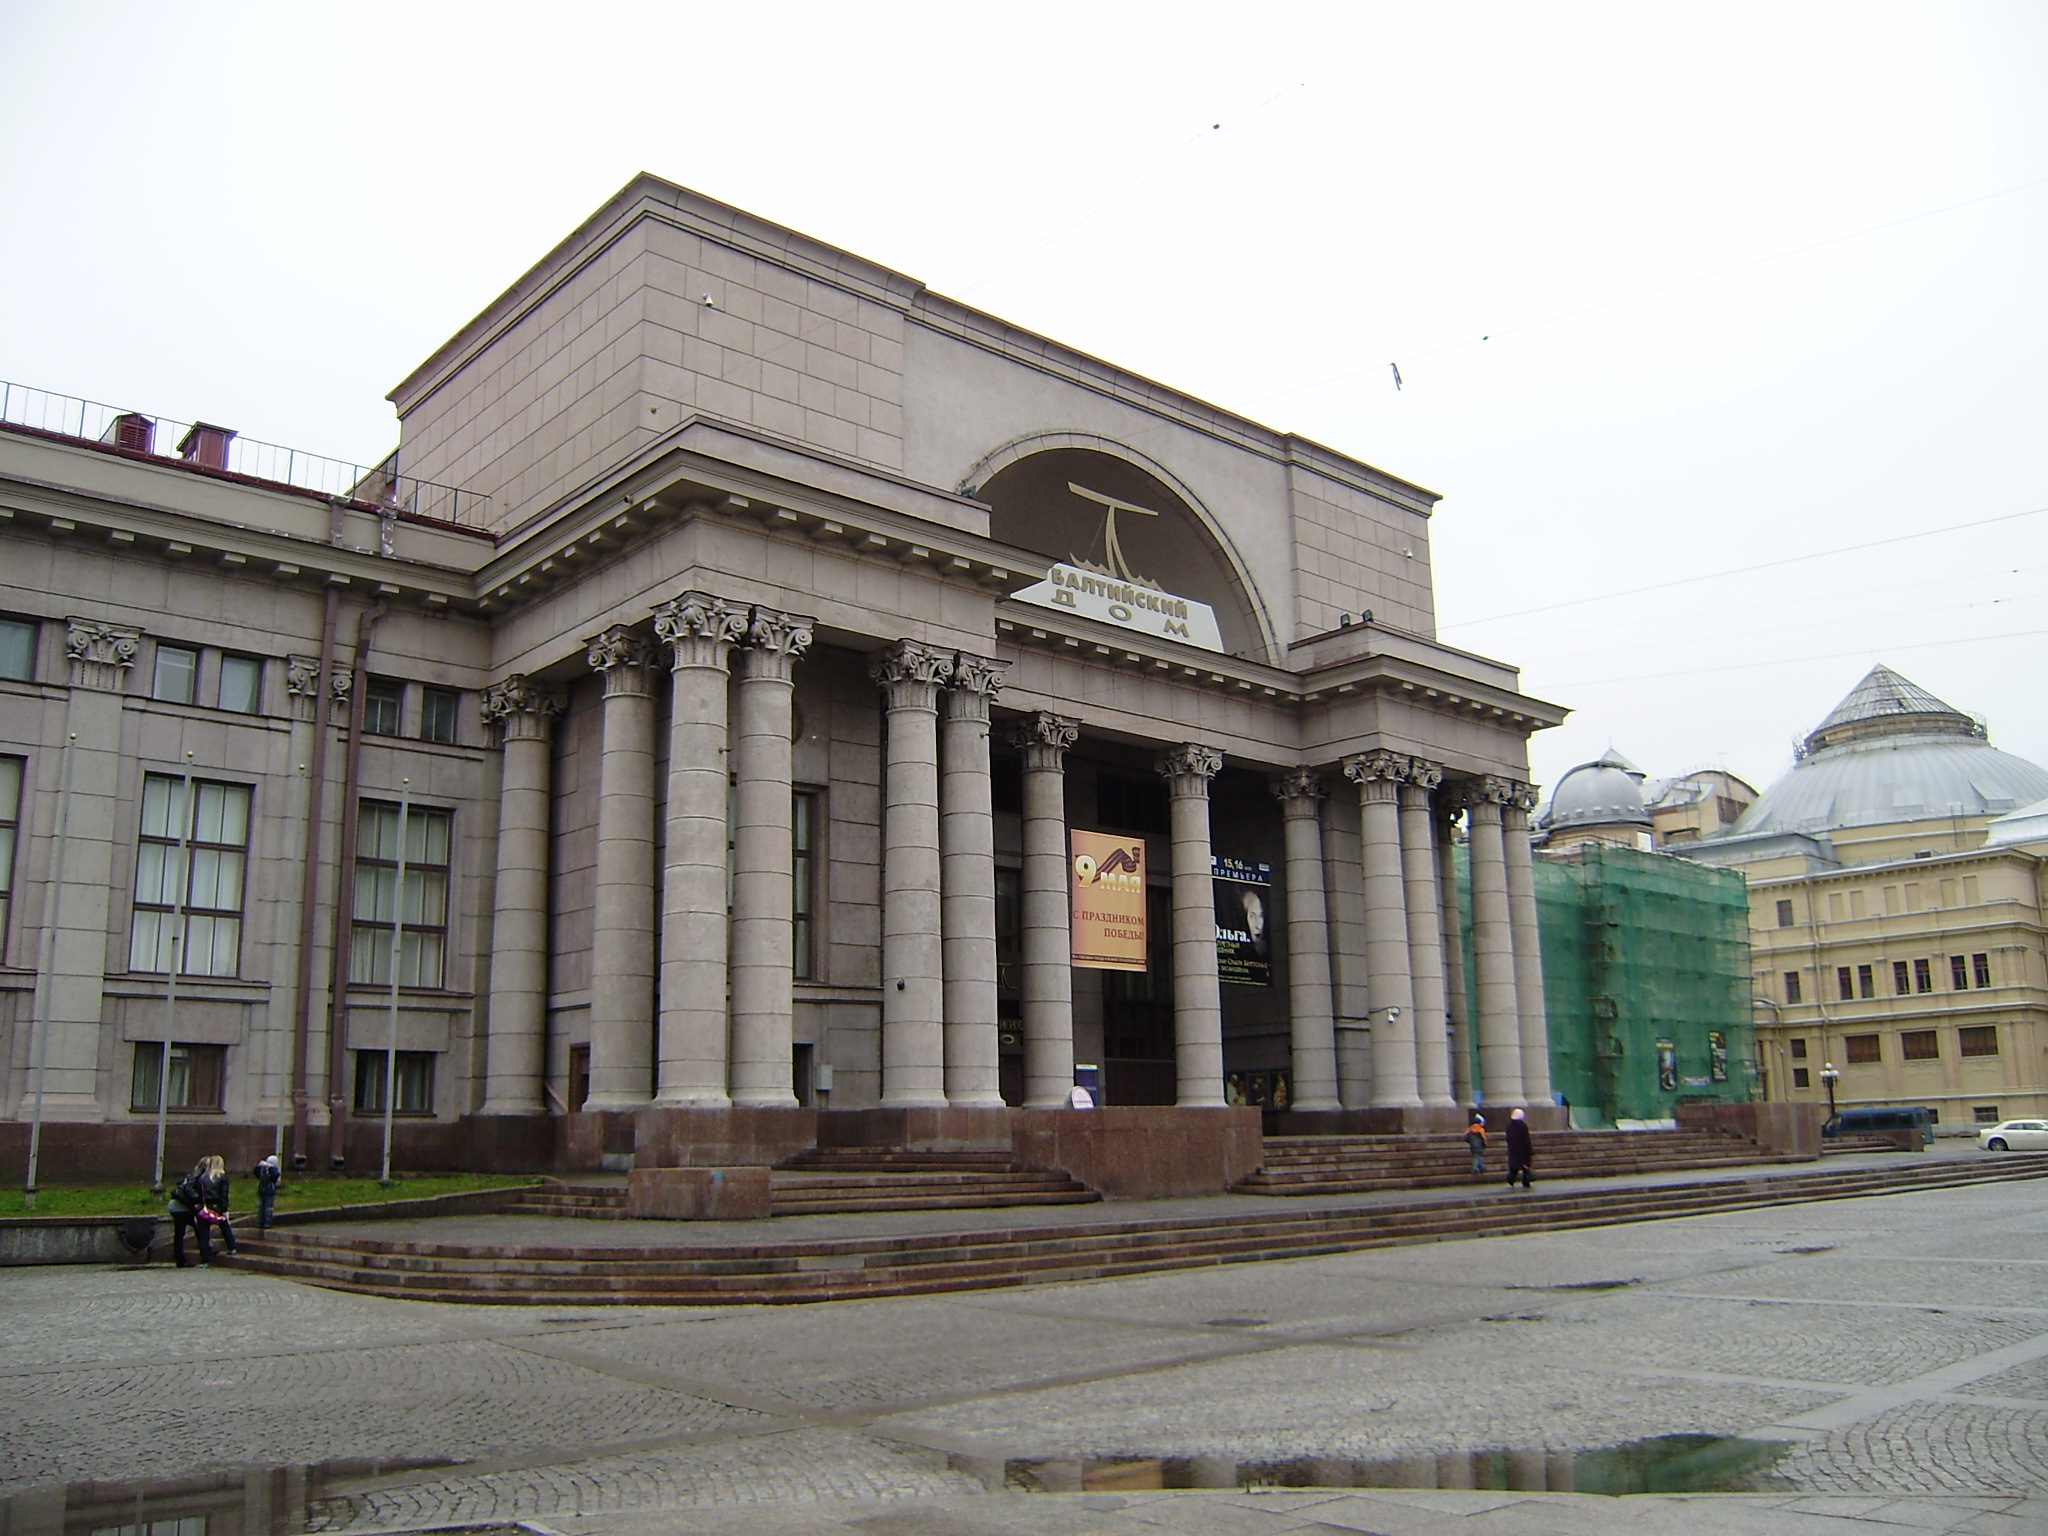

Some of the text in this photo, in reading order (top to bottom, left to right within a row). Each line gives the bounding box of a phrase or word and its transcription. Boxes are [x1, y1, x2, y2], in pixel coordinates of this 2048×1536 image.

[1050, 589, 1189, 638] ДОМ
[1051, 568, 1188, 620] БАЛТИЙСКИЙ
[1075, 854, 1141, 894] 9 МАЯ
[1213, 867, 1263, 882] ПРЕМЬЕРА
[1072, 910, 1145, 926] С ПРАЗДНИКОМ
